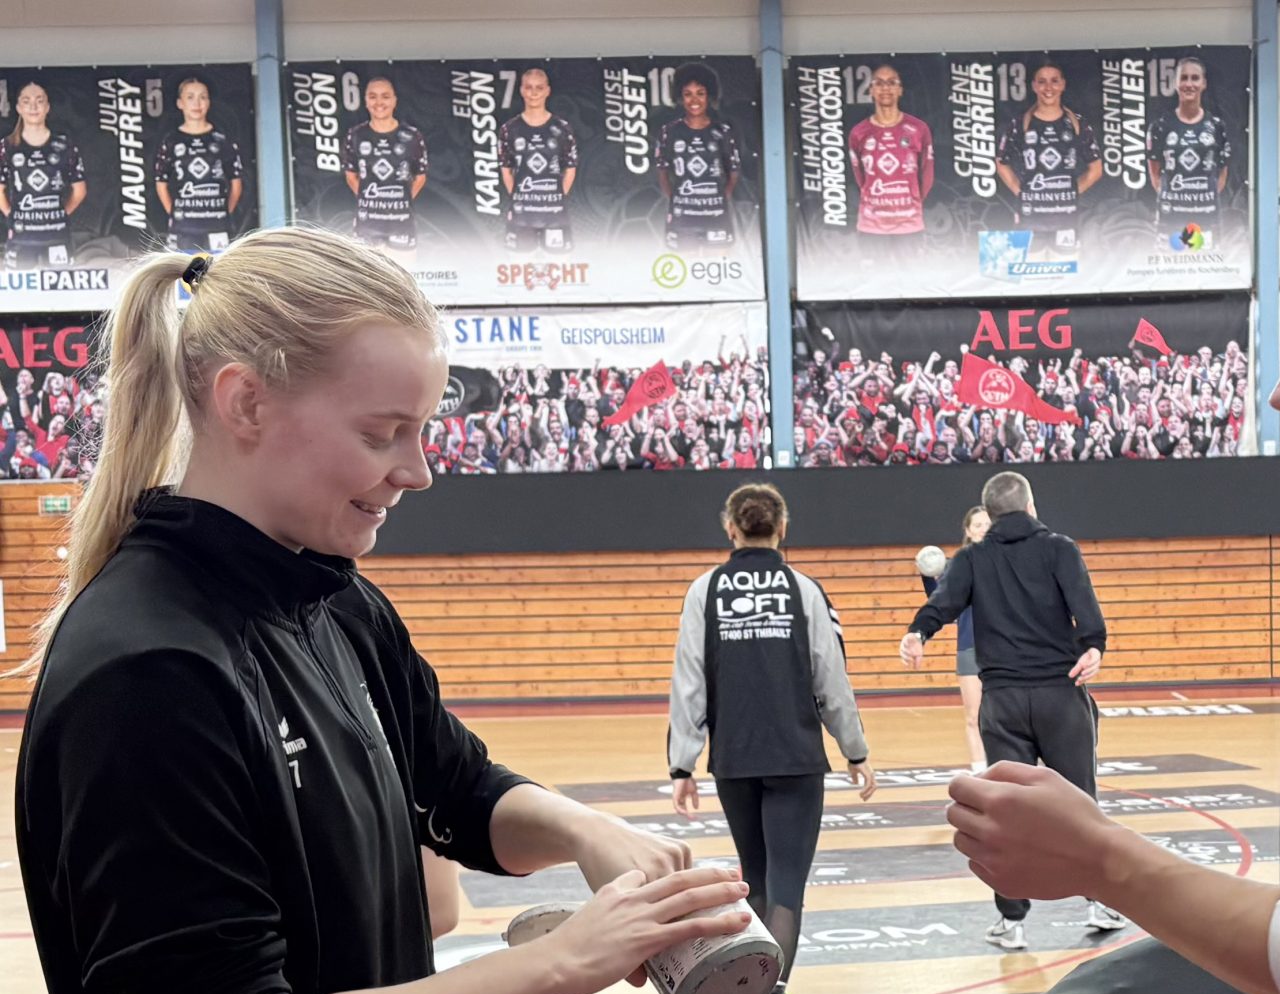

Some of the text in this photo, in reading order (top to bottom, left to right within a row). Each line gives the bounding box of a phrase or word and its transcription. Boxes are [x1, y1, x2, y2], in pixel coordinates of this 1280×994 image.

[341, 71, 361, 111] 6
[451, 70, 472, 118] ELIN
[499, 70, 517, 109] 7
[843, 65, 874, 105] 12
[997, 63, 1027, 102] 13
[1147, 58, 1177, 97] 15
[98, 78, 119, 135] JULIA
[145, 78, 164, 118] 5
[293, 72, 315, 136] LILOU
[603, 69, 625, 142] LOUISE
[311, 72, 341, 173] BEGON
[622, 68, 650, 174] CUSSET
[798, 66, 822, 193] ELIHANNAH
[970, 62, 997, 198] GUERRIER
[1102, 59, 1123, 178] CORENTINE
[1122, 58, 1147, 190] CAVALIER
[117, 78, 147, 229] MAUFFREY
[470, 71, 501, 216] KARLSSON
[0, 271, 107, 290] UE PARK
[497, 262, 590, 289] SPECHT
[691, 256, 743, 286] egis
[1011, 262, 1071, 275] Univer
[0, 326, 89, 369] AEG
[454, 315, 541, 344] STANE
[560, 326, 666, 345] GEISPOLSHEIM
[971, 308, 1073, 351] AEG
[716, 570, 790, 593] AQUA
[743, 629, 753, 639] ST
[288, 760, 302, 788] 7
[800, 938, 930, 953] OMPANY
